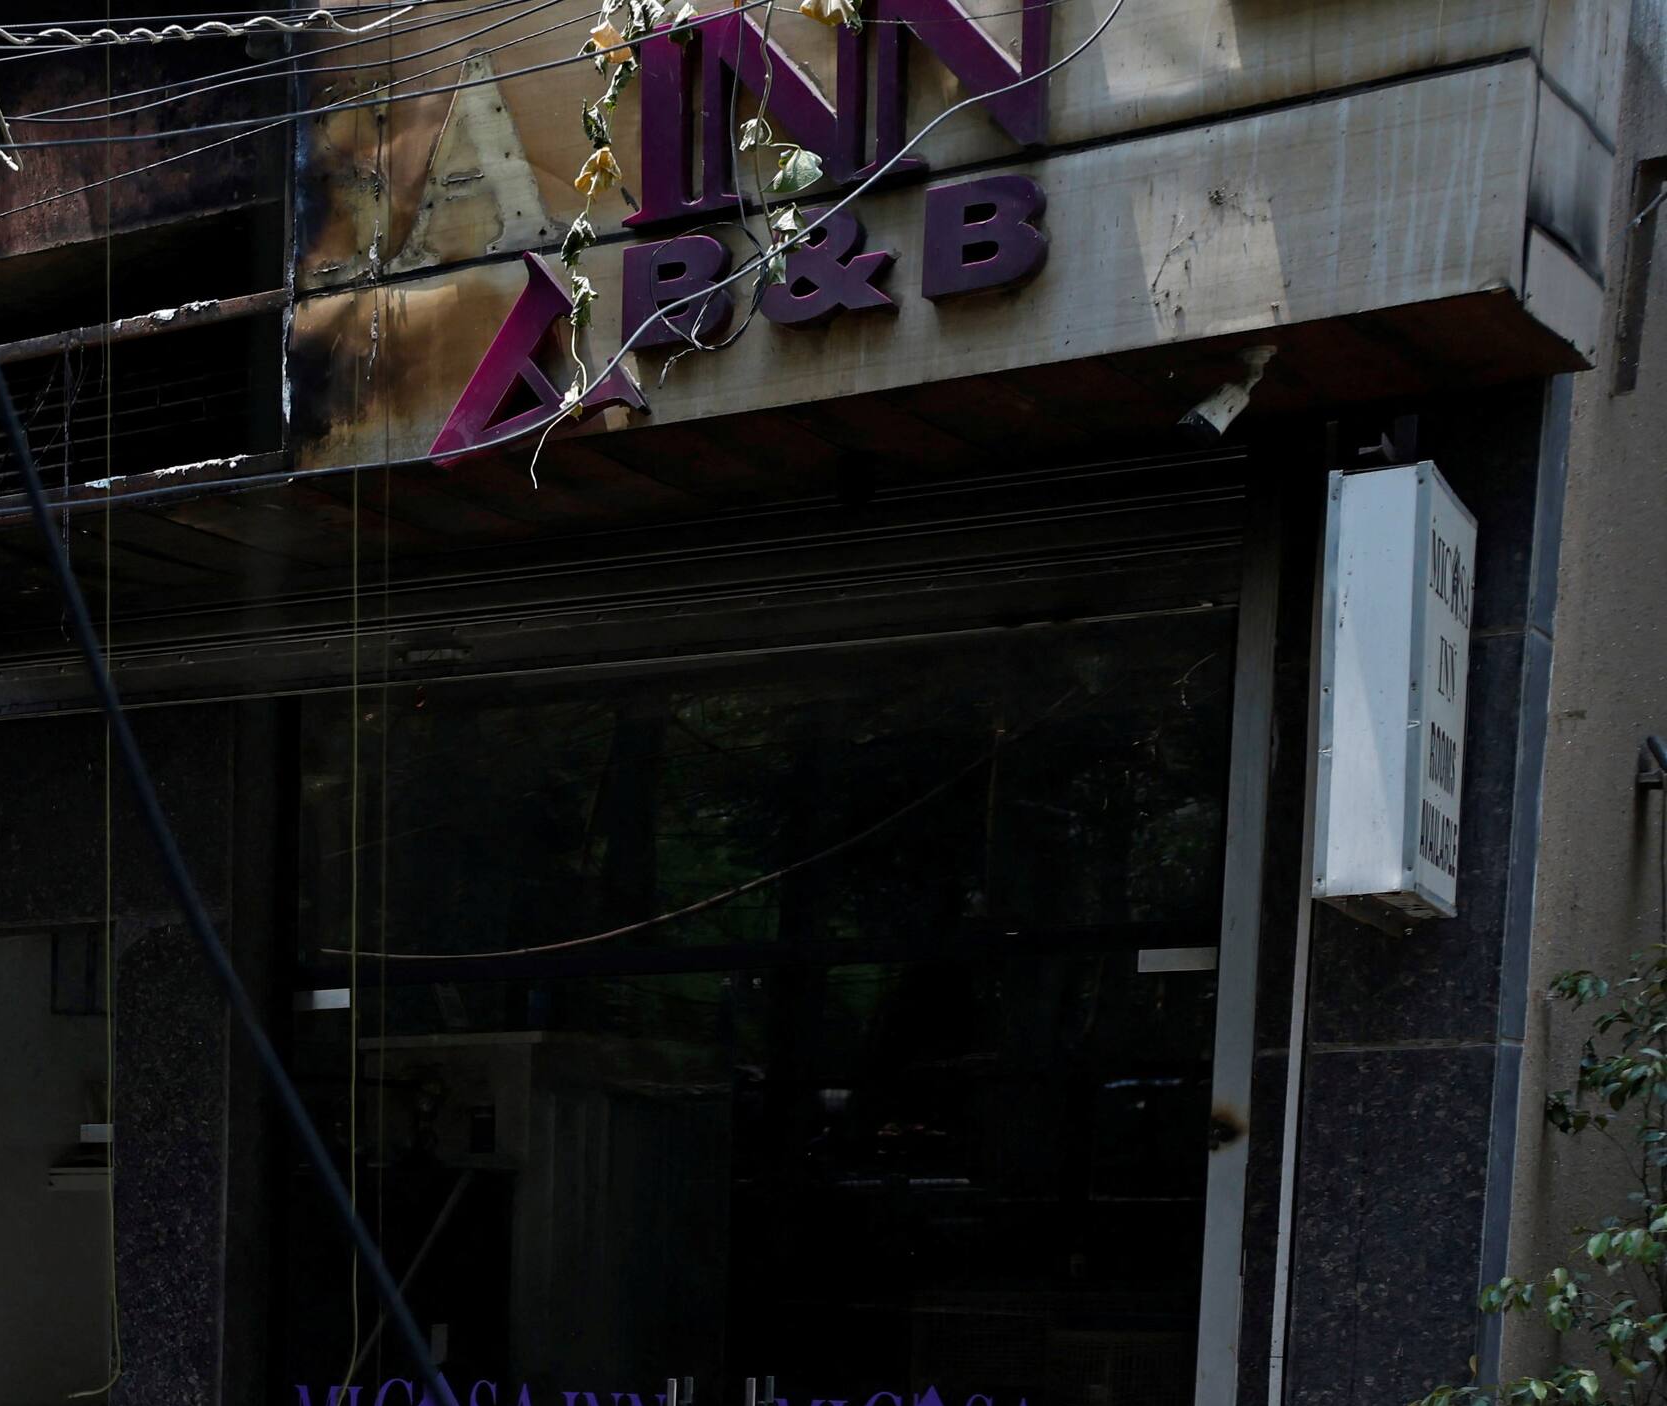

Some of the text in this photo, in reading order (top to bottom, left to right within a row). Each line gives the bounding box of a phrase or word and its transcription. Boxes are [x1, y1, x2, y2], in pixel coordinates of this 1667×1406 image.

[622, 0, 1049, 228] INN
[1429, 721, 1456, 796] ROOMS
[1419, 798, 1458, 878] AVAILABLE
